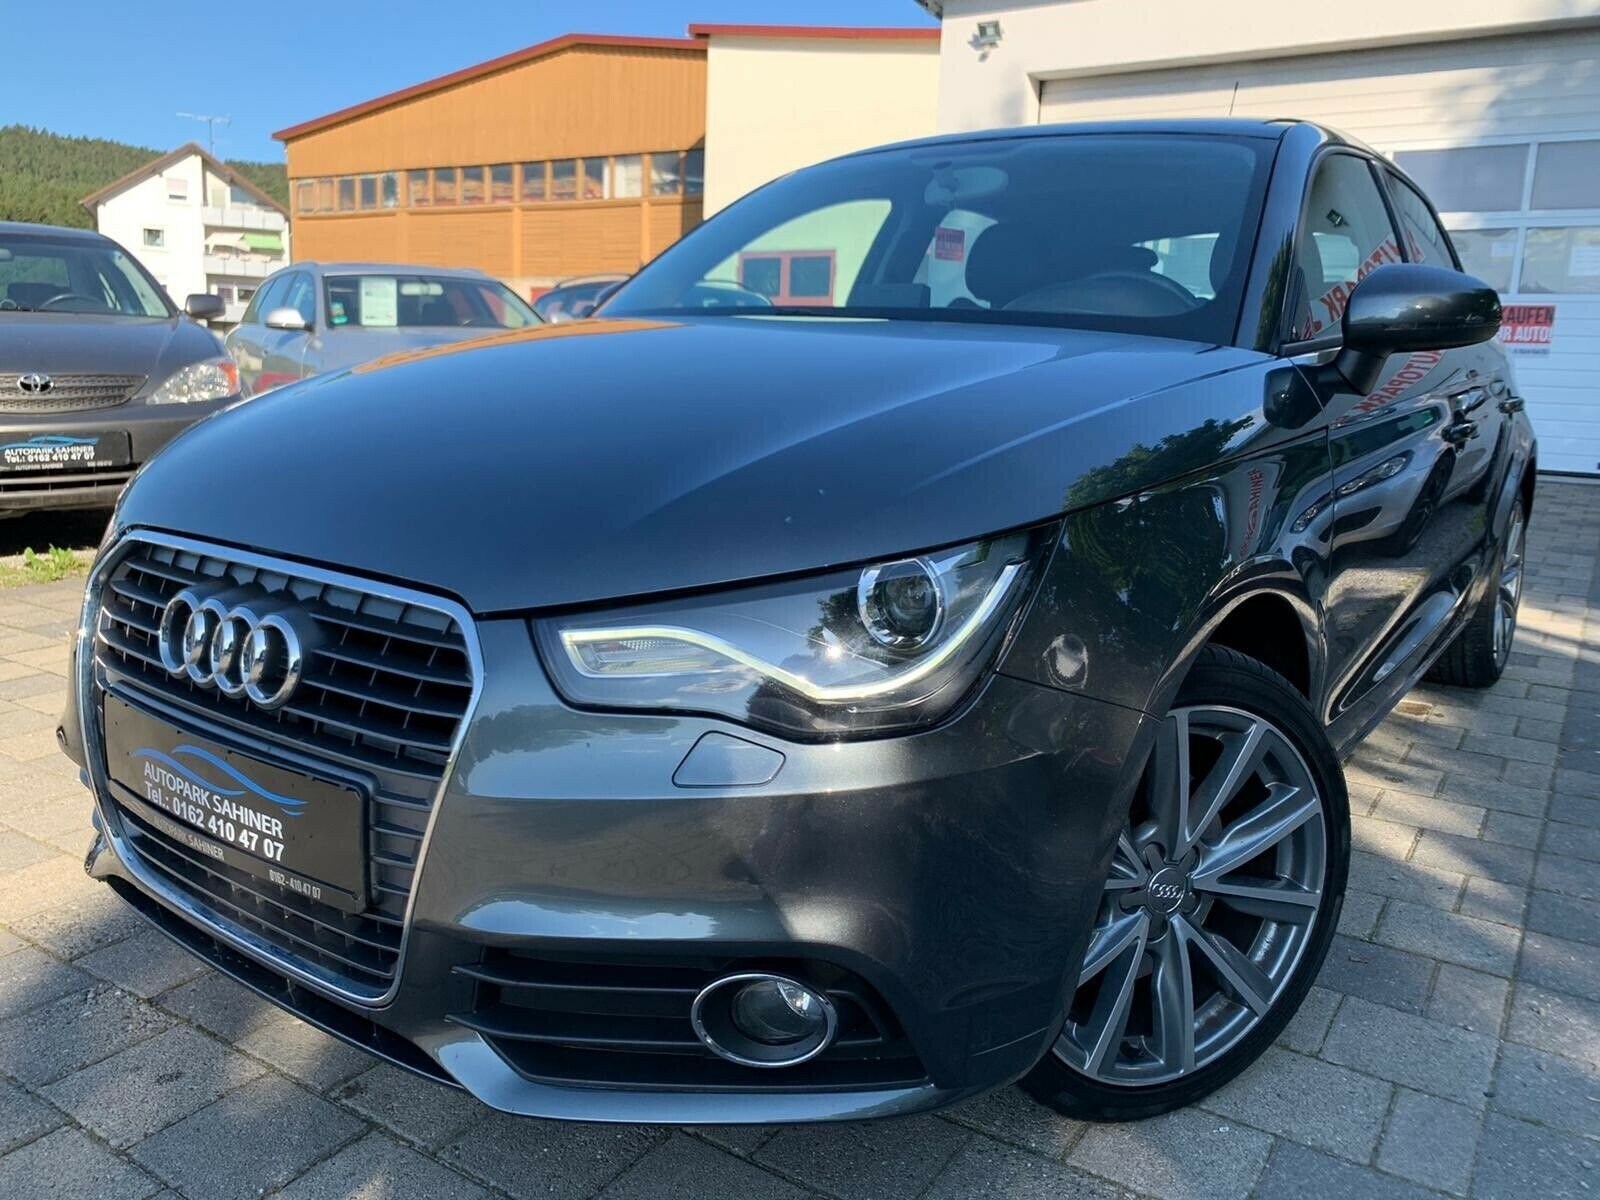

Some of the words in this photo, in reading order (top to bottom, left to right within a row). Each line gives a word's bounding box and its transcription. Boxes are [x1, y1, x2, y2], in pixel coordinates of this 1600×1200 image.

[4, 448, 54, 457] AUTOPARK
[55, 445, 95, 455] SAHINER
[27, 454, 50, 462] 0162
[52, 453, 68, 461] 410
[70, 453, 82, 461] 47
[84, 451, 95, 460] 07
[143, 761, 212, 810] AUTOPARK
[212, 795, 284, 840] SAHINER
[144, 780, 170, 811] Tel.:
[172, 796, 205, 829] 0162
[207, 815, 235, 843] 410
[238, 829, 259, 852] 47
[263, 838, 285, 862] 07
[189, 836, 225, 861] SAHINER
